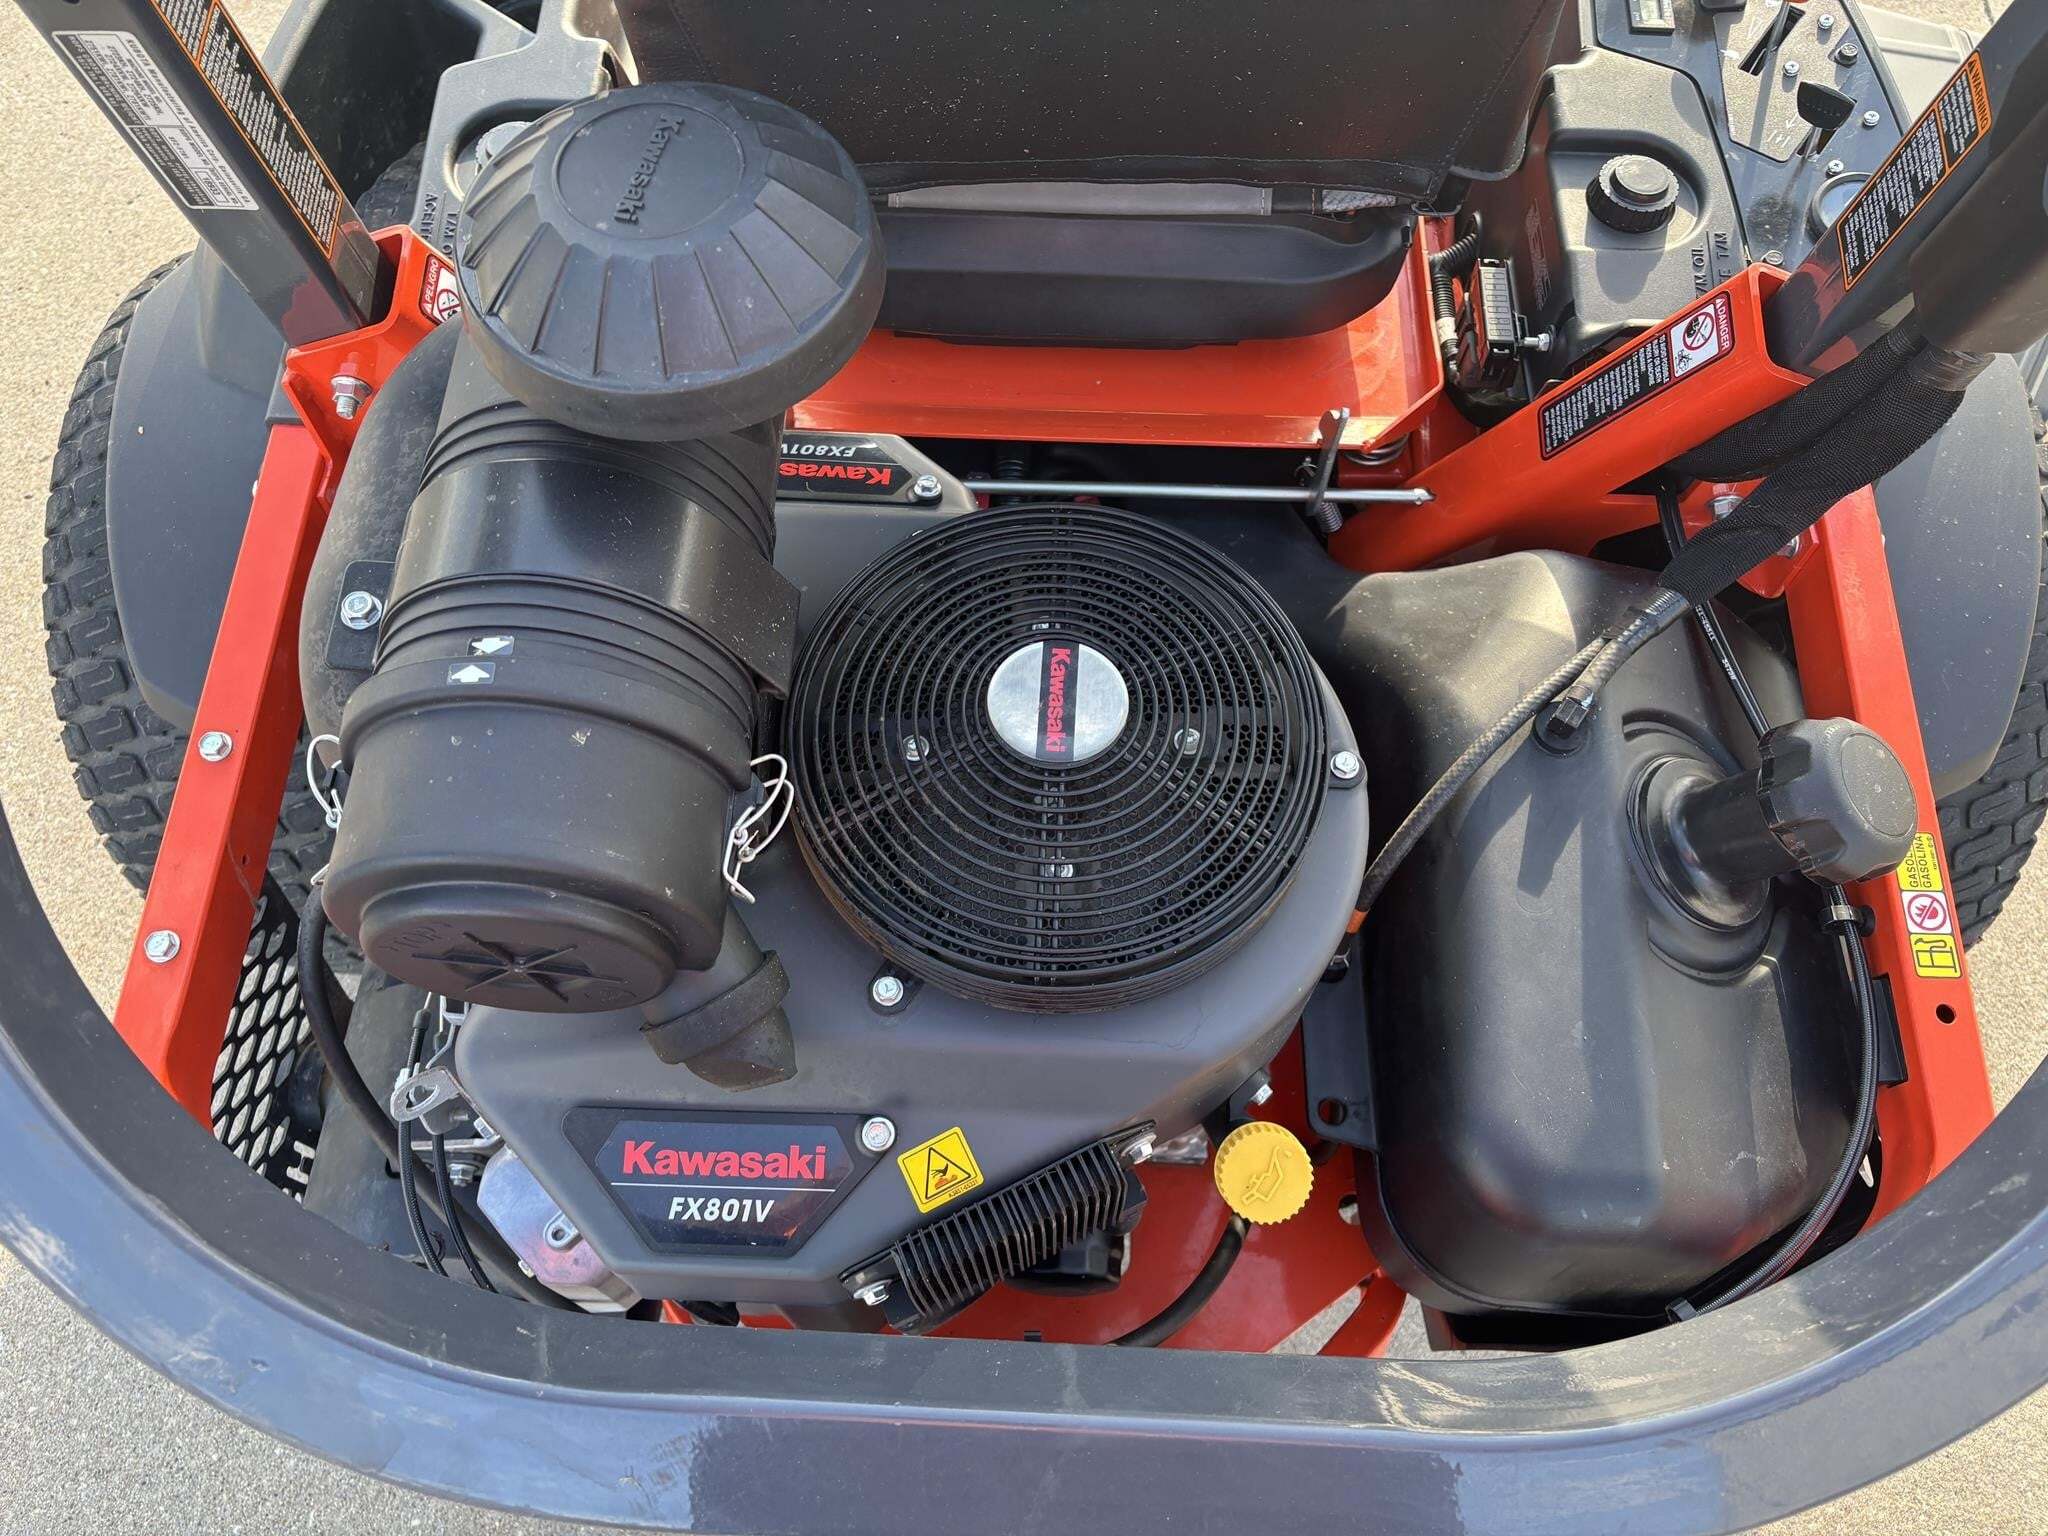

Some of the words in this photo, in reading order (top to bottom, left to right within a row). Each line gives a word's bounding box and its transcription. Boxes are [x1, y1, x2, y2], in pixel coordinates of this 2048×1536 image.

[124, 39, 152, 66] KUBOTA
[1970, 67, 1989, 131] WARNING
[615, 114, 684, 225] Kawasaki
[1714, 232, 1730, 259] T/M
[424, 259, 439, 302] PELIGRO
[1717, 307, 1731, 350] DANGER
[780, 462, 892, 485] Kawas
[1046, 647, 1071, 753] Kawasaki
[1906, 852, 1919, 888] GASOL
[1916, 835, 1932, 888] GASOLINA
[623, 1140, 826, 1180] Kawasaki
[668, 1196, 775, 1223] FX801V
